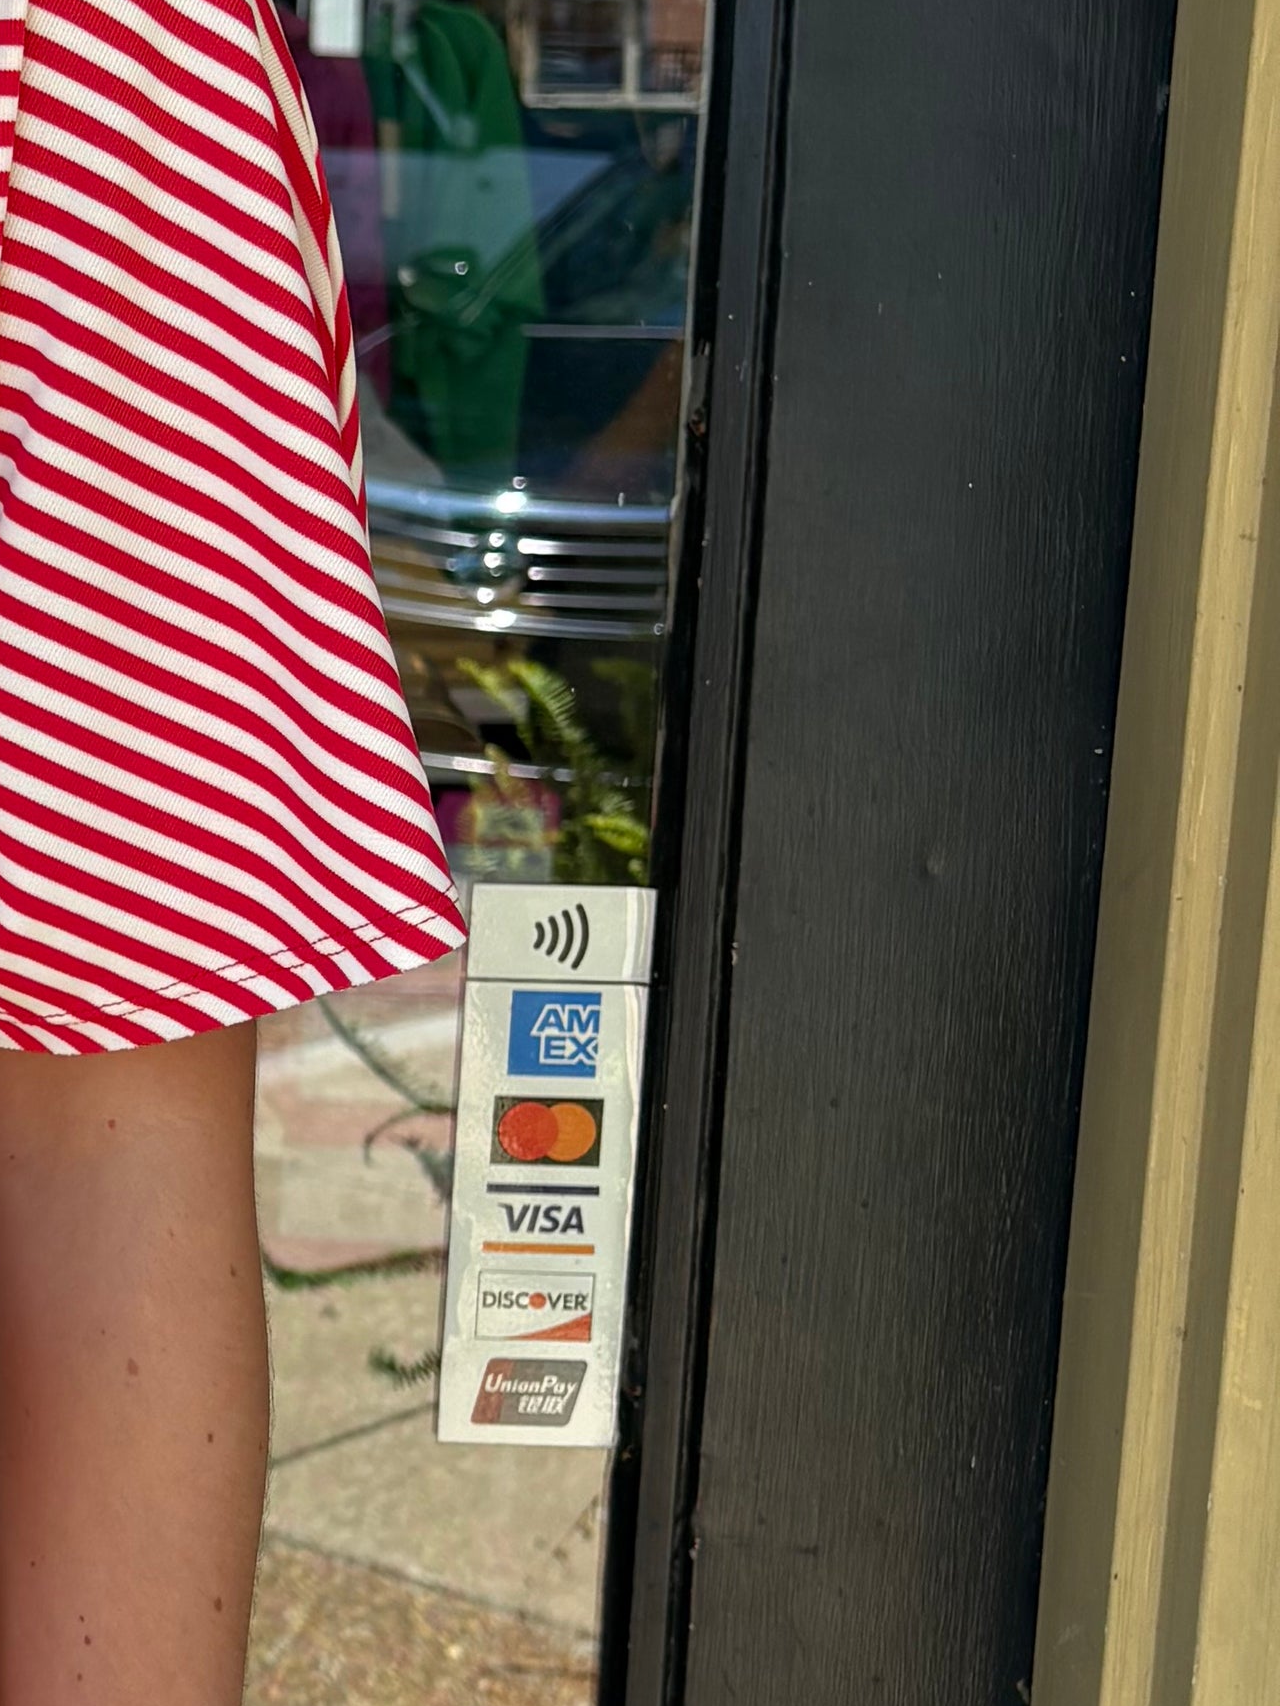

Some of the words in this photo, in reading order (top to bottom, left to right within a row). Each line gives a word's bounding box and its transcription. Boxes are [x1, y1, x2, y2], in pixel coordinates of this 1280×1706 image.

[530, 1004, 601, 1036] AM
[539, 1035, 598, 1065] EX
[497, 1202, 585, 1234] VISA
[482, 1291, 589, 1311] DISCOVER
[484, 1373, 578, 1403] UnionPay
